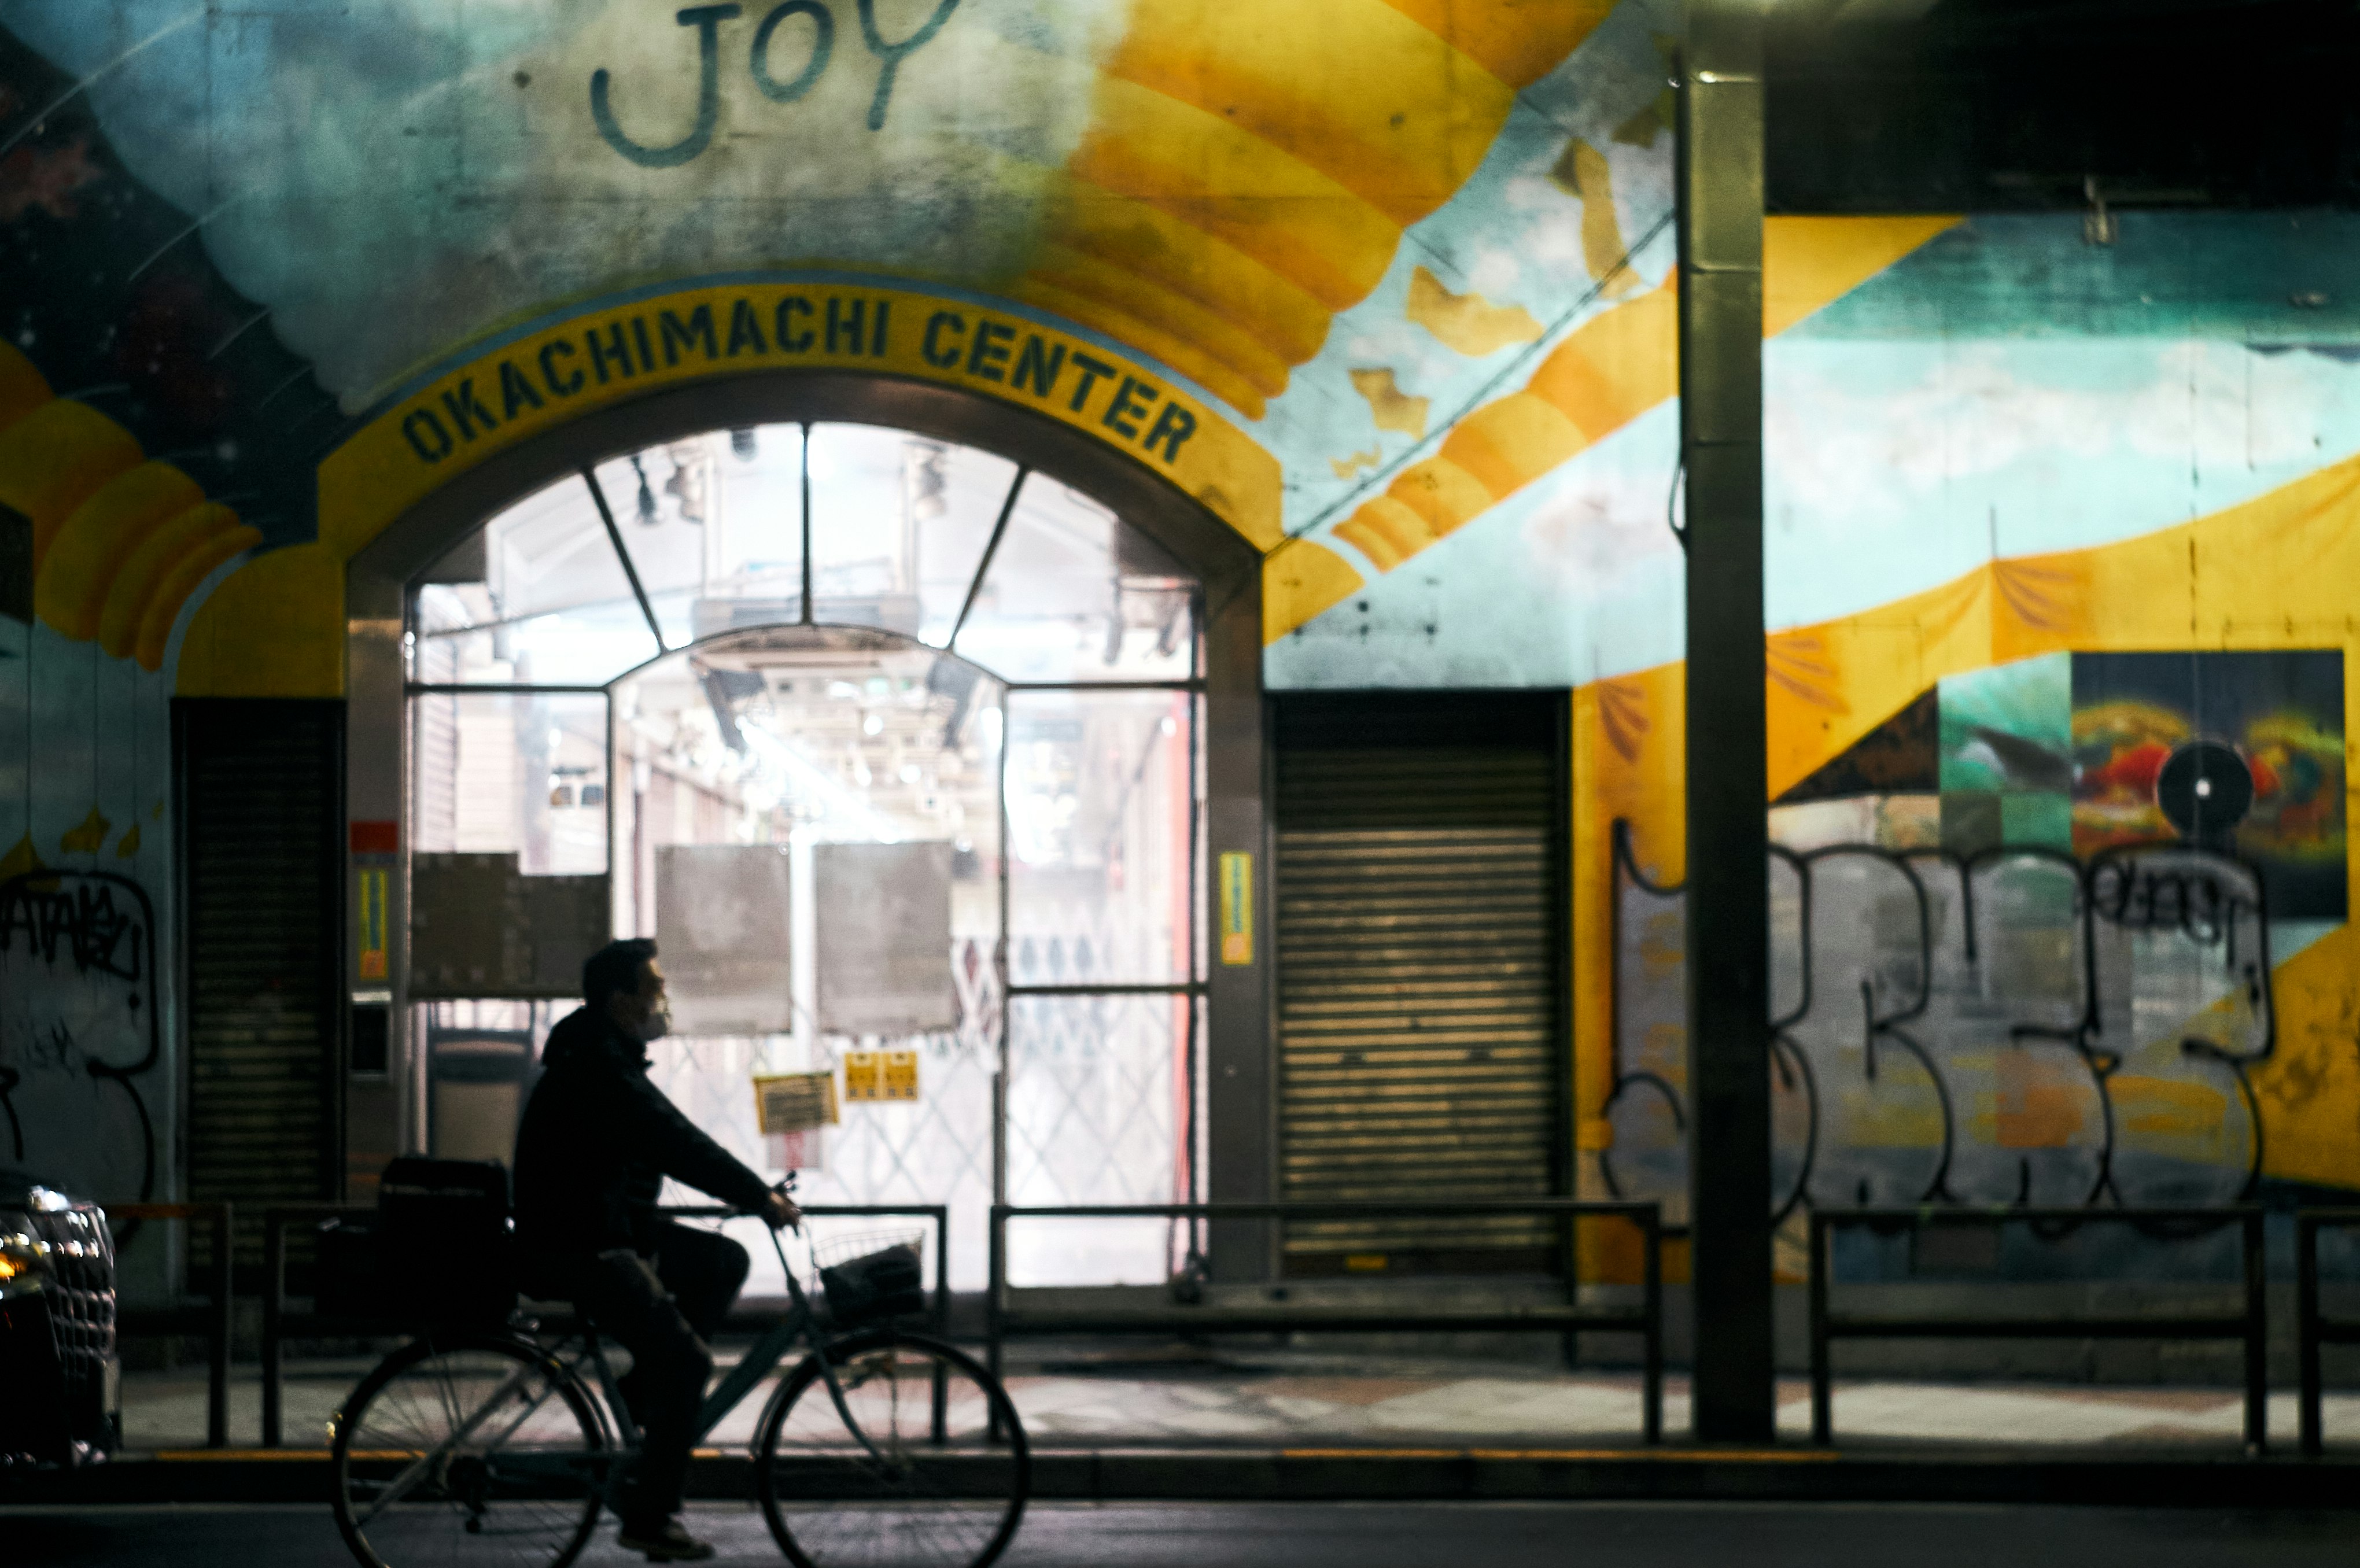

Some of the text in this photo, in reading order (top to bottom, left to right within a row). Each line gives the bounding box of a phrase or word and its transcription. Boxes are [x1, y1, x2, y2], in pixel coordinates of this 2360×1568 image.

[590, 0, 961, 168] JOY
[402, 296, 1197, 464] OKACHIMACHI CENTER
